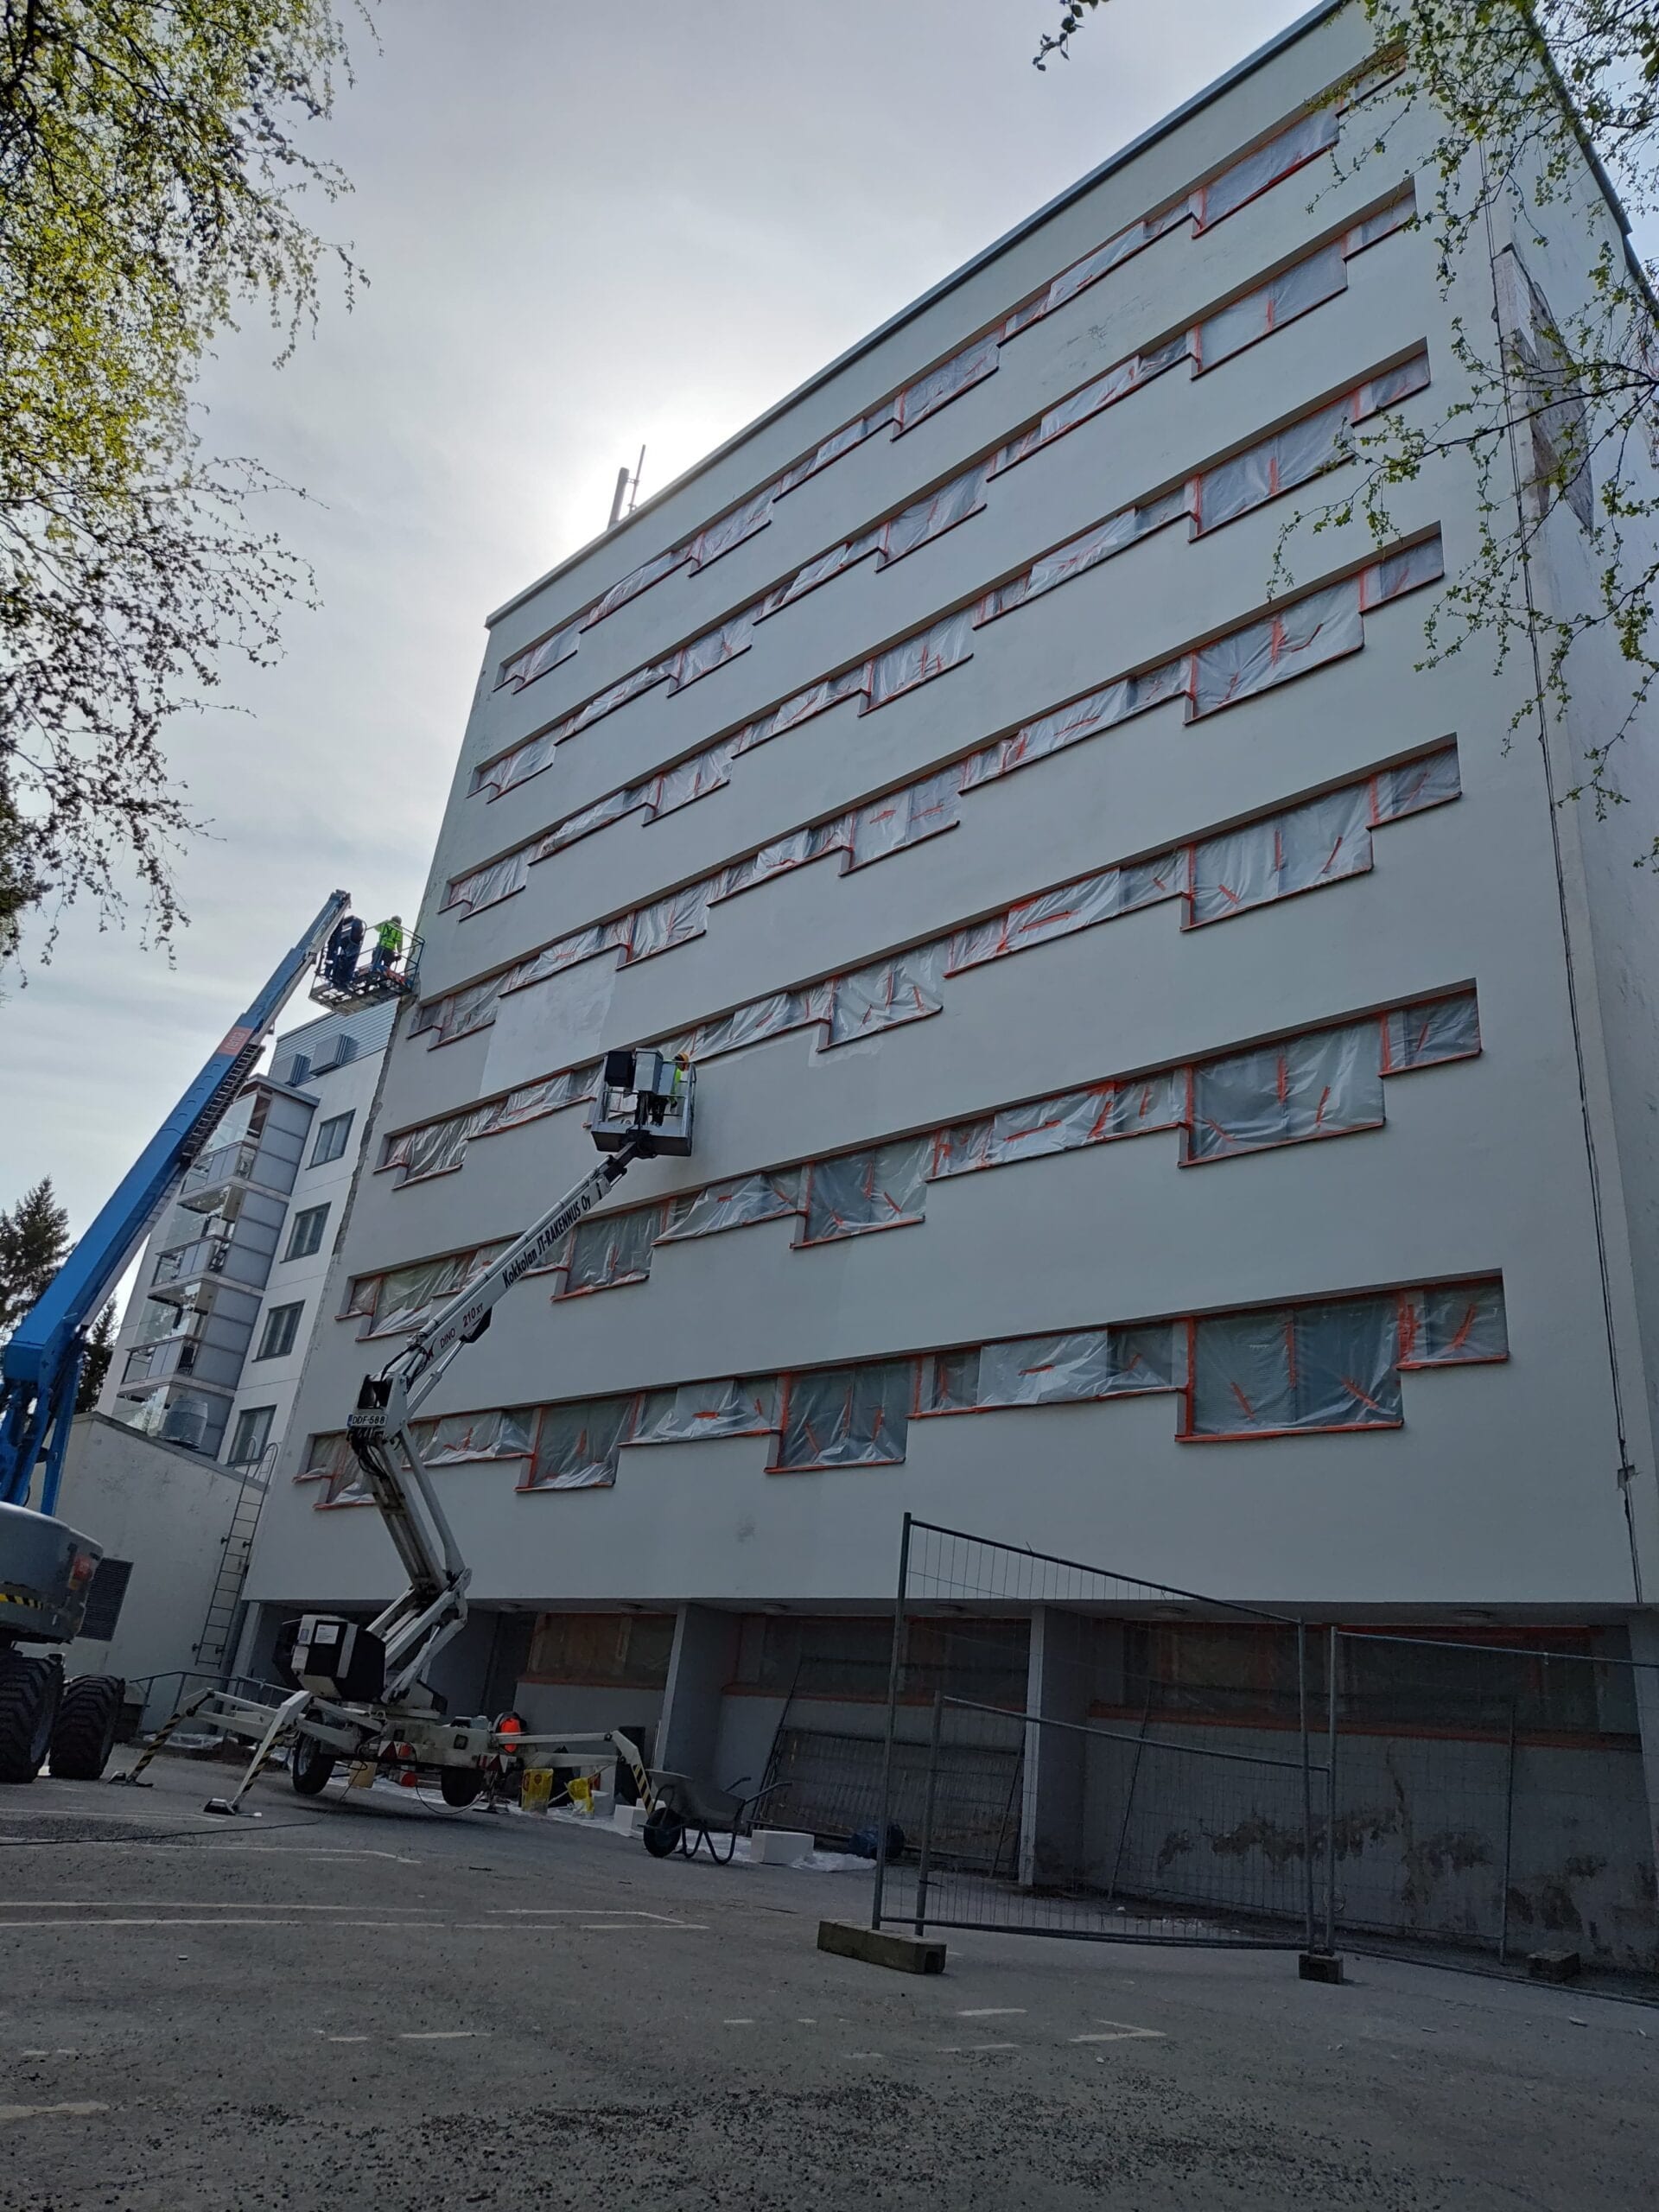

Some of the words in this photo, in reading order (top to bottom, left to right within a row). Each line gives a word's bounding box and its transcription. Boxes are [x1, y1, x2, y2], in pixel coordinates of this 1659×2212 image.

[502, 1248, 538, 1288] Kokkolan
[537, 1201, 581, 1255] JT-RAKENNUS
[581, 1195, 591, 1211] Oy
[440, 1327, 455, 1349] DINO
[352, 1415, 385, 1424] DDF-588
